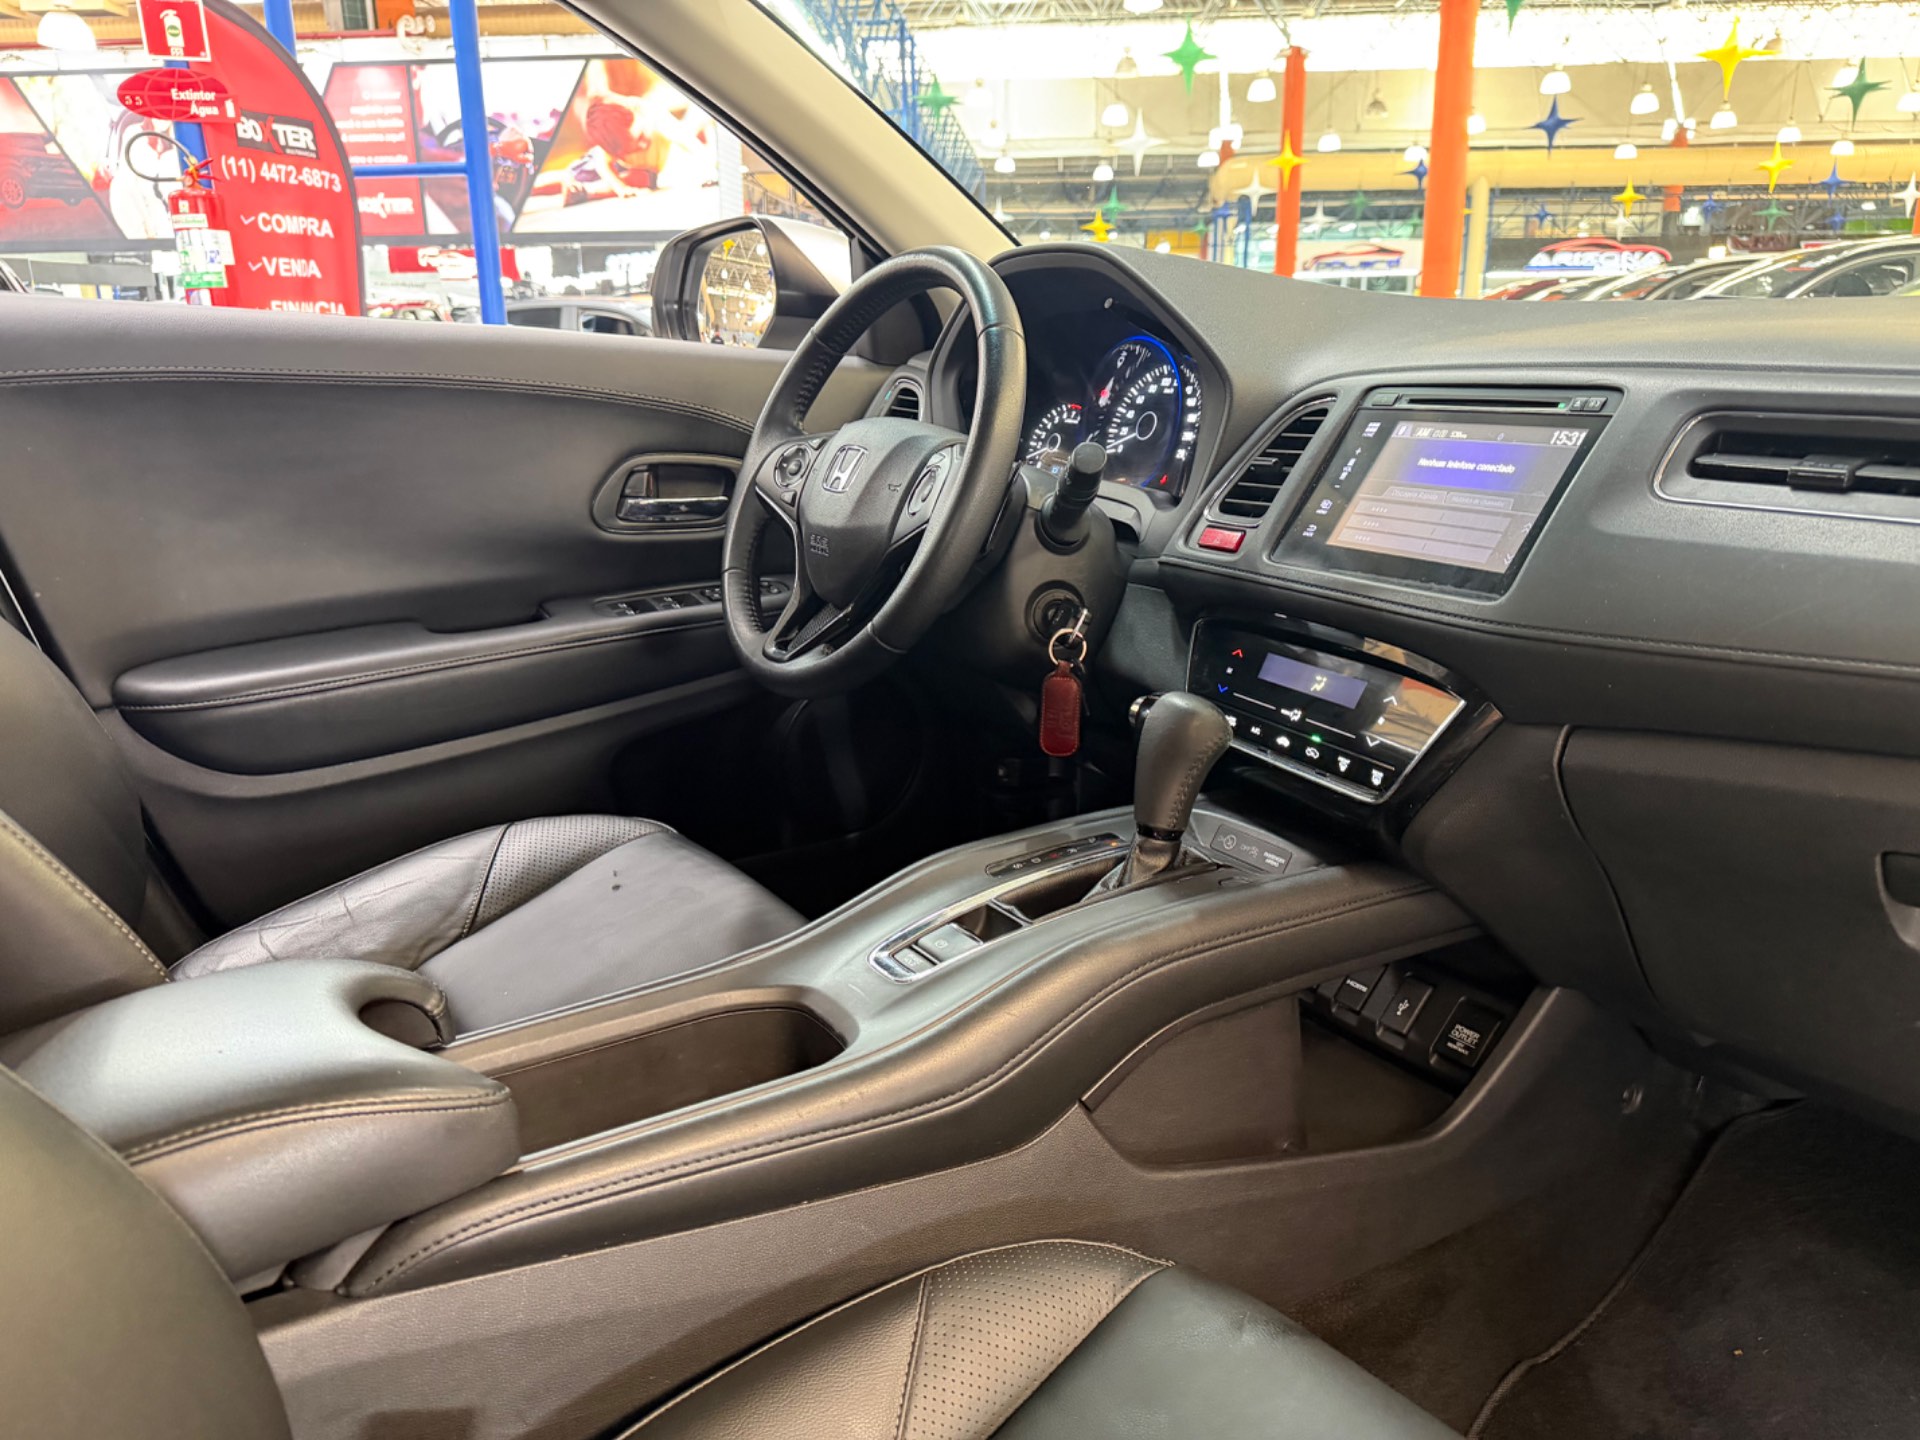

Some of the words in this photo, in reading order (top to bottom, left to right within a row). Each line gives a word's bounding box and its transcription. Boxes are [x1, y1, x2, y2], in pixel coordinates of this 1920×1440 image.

[170, 88, 216, 101] Extintor
[190, 101, 220, 118] Água
[235, 114, 318, 153] BOXTER
[221, 154, 256, 184] (11)
[259, 161, 342, 193] 4472-6873
[257, 212, 335, 239] COMPRA
[261, 256, 323, 279] VENDA
[1417, 457, 1447, 468] Nenhum
[1446, 459, 1476, 471] telefone
[1451, 1030, 1479, 1045] OUTLET
[1455, 1023, 1480, 1039] POWER
